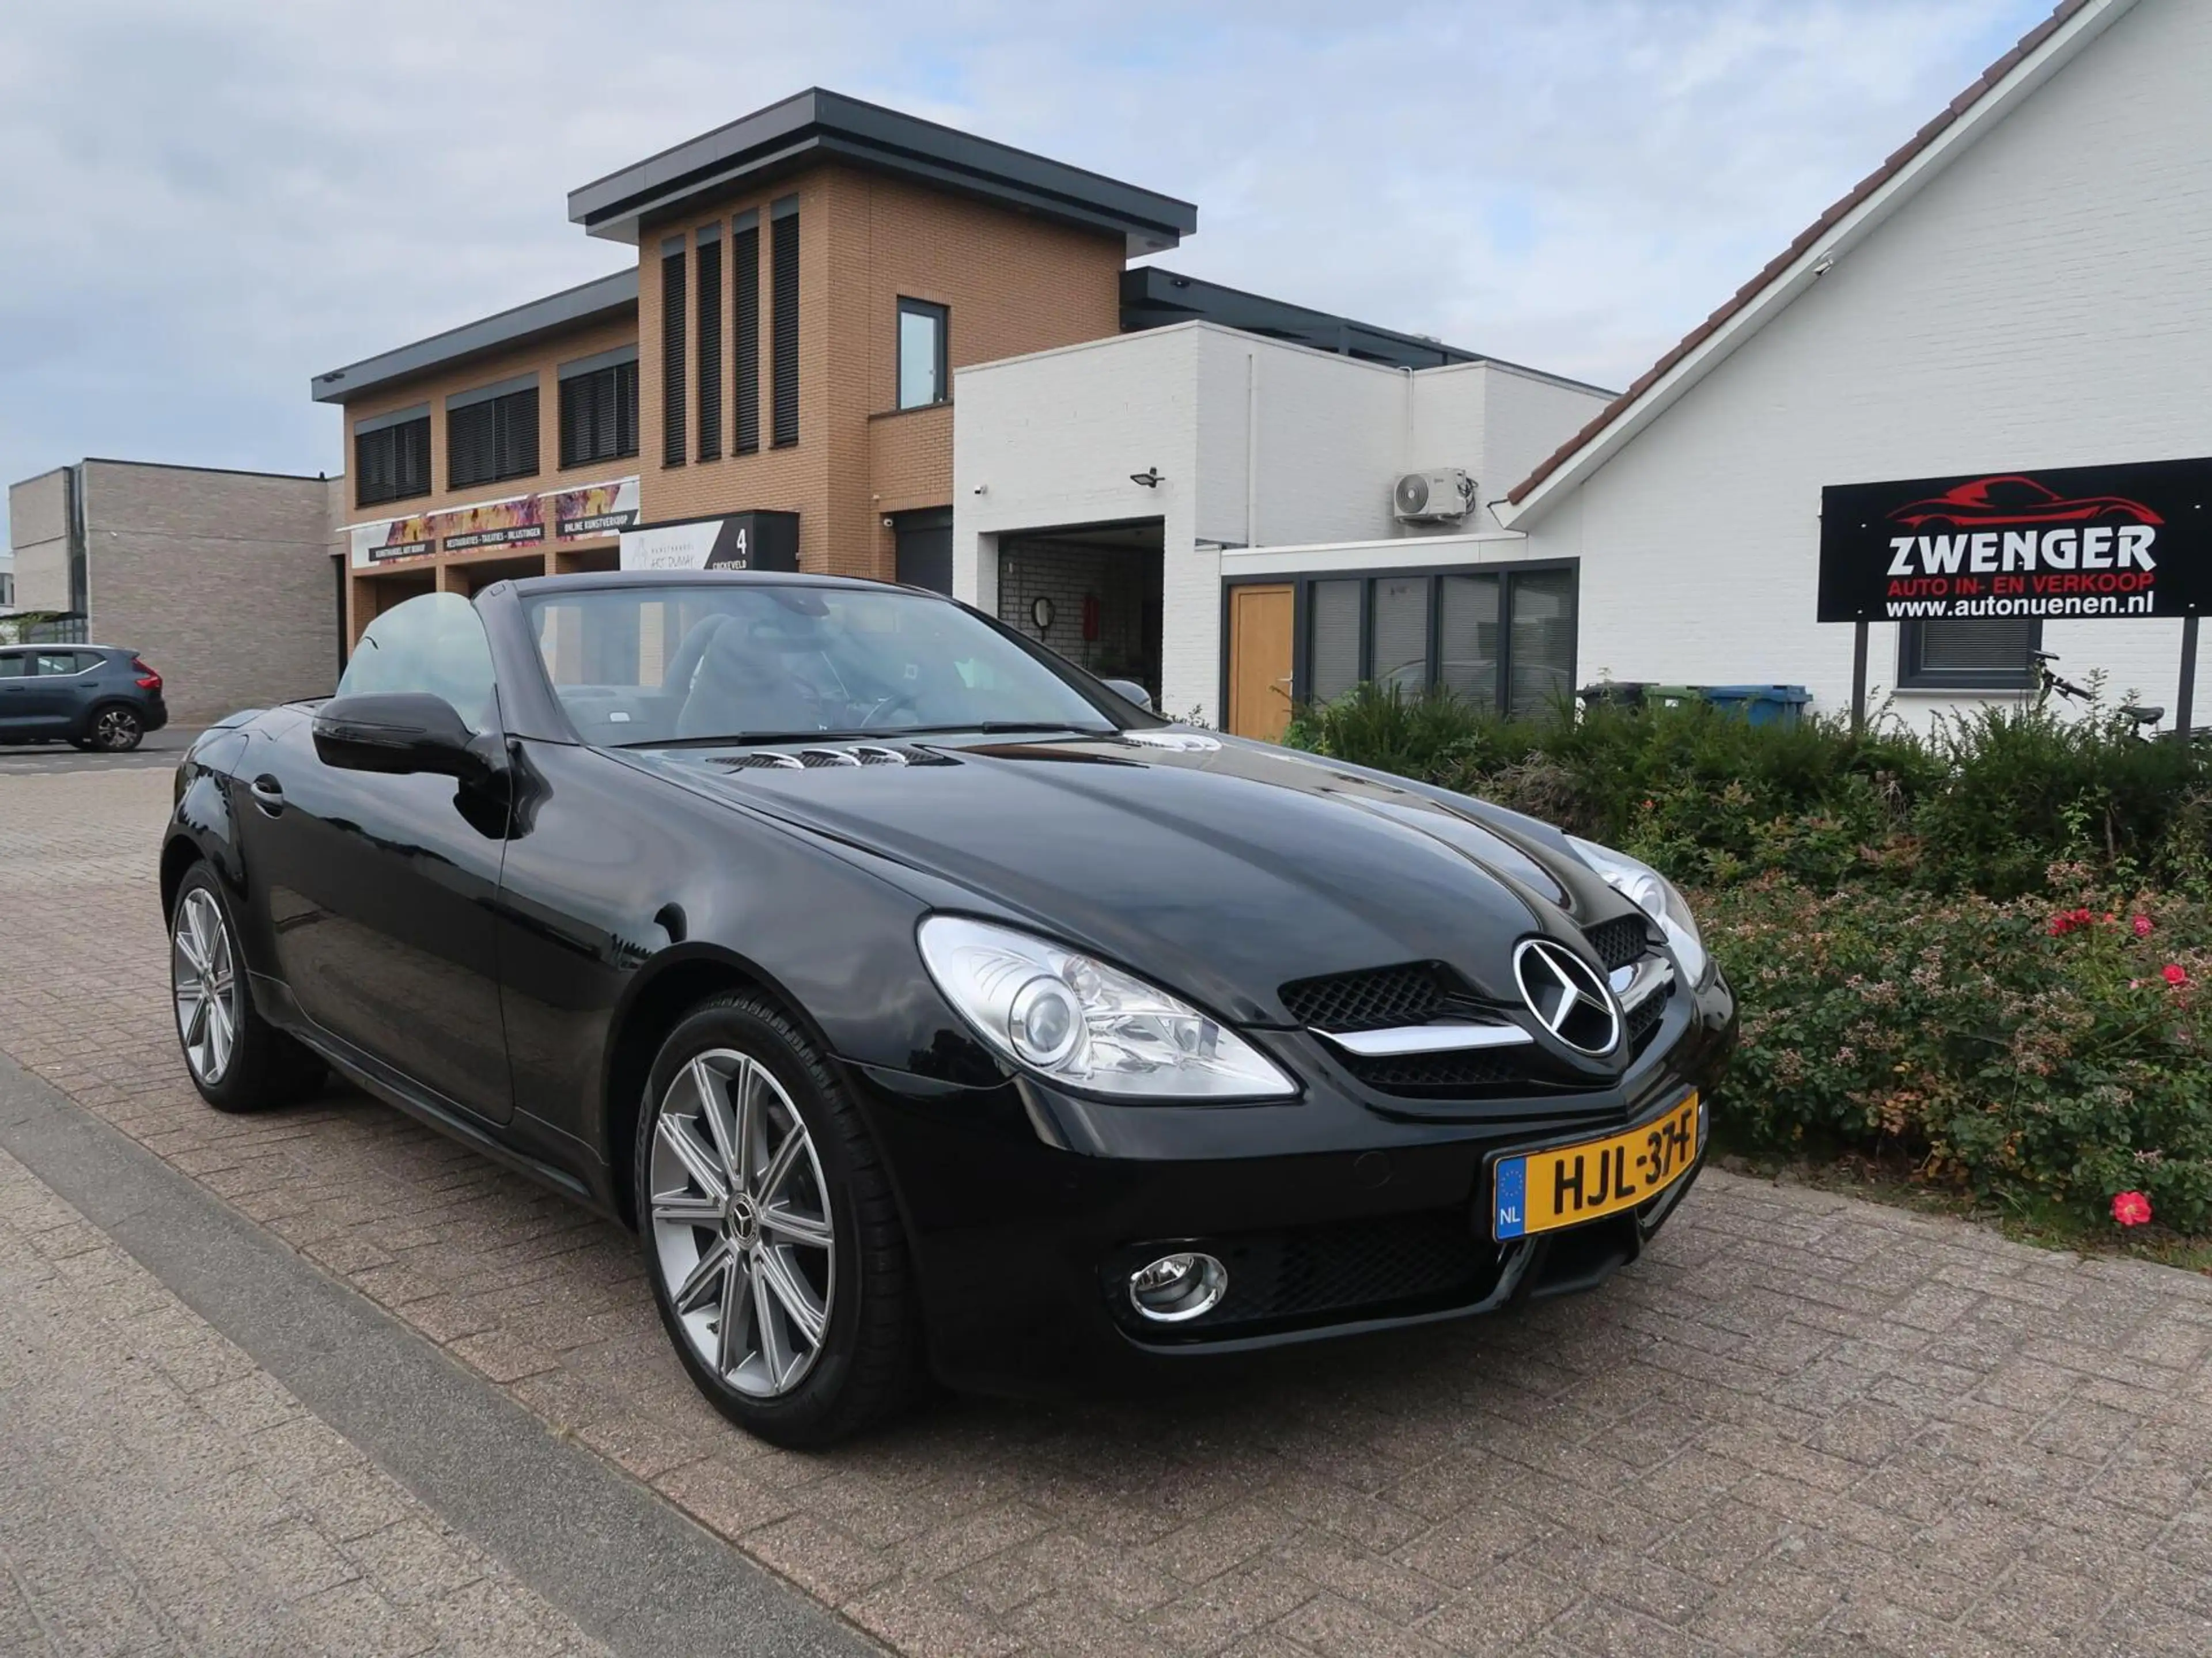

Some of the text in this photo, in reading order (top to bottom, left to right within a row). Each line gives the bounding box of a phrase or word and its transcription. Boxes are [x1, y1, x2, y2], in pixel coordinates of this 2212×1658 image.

[737, 529, 747, 554] 4
[1887, 525, 2157, 575] ZWENGER
[1888, 572, 2154, 596] AUTO IN- EN VERKOOP
[1886, 591, 2154, 617] www.autonuenen.nl
[1500, 1206, 1521, 1225] NL
